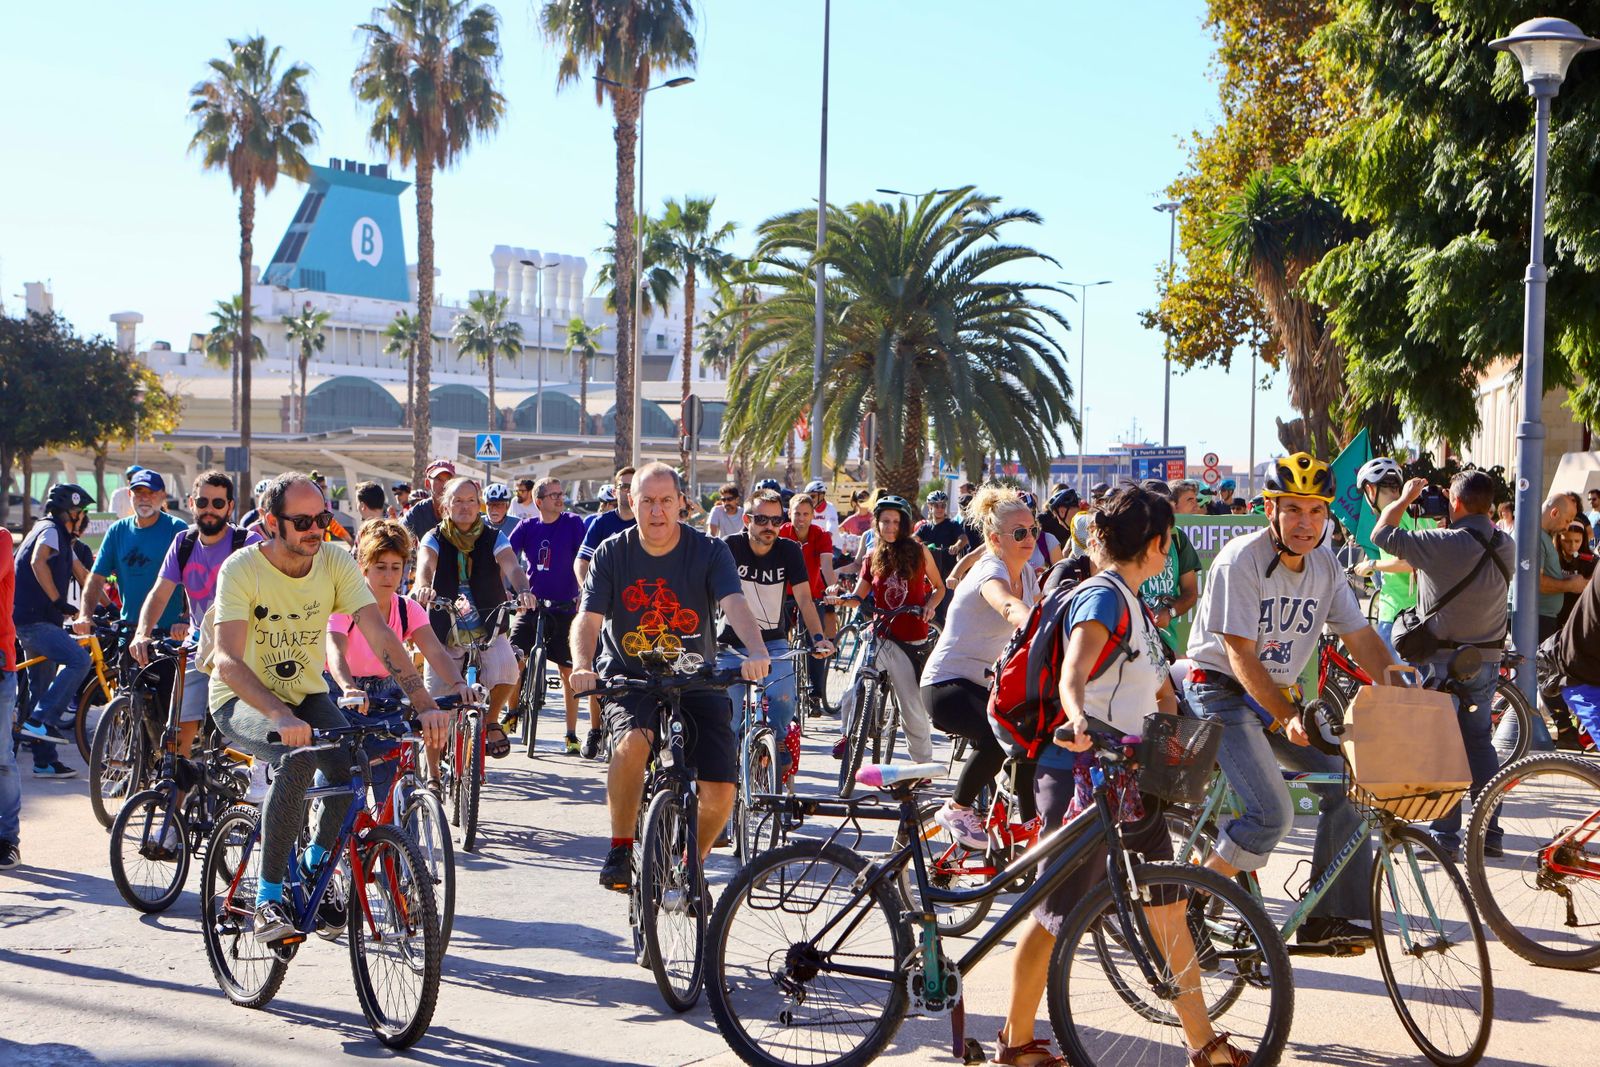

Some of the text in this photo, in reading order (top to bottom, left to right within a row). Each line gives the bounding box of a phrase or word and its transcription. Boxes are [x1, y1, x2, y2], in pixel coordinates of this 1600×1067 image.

[361, 223, 375, 255] B
[1148, 580, 1175, 595] MAR
[1258, 595, 1320, 636] AUS
[255, 629, 322, 649] JUÁREZ
